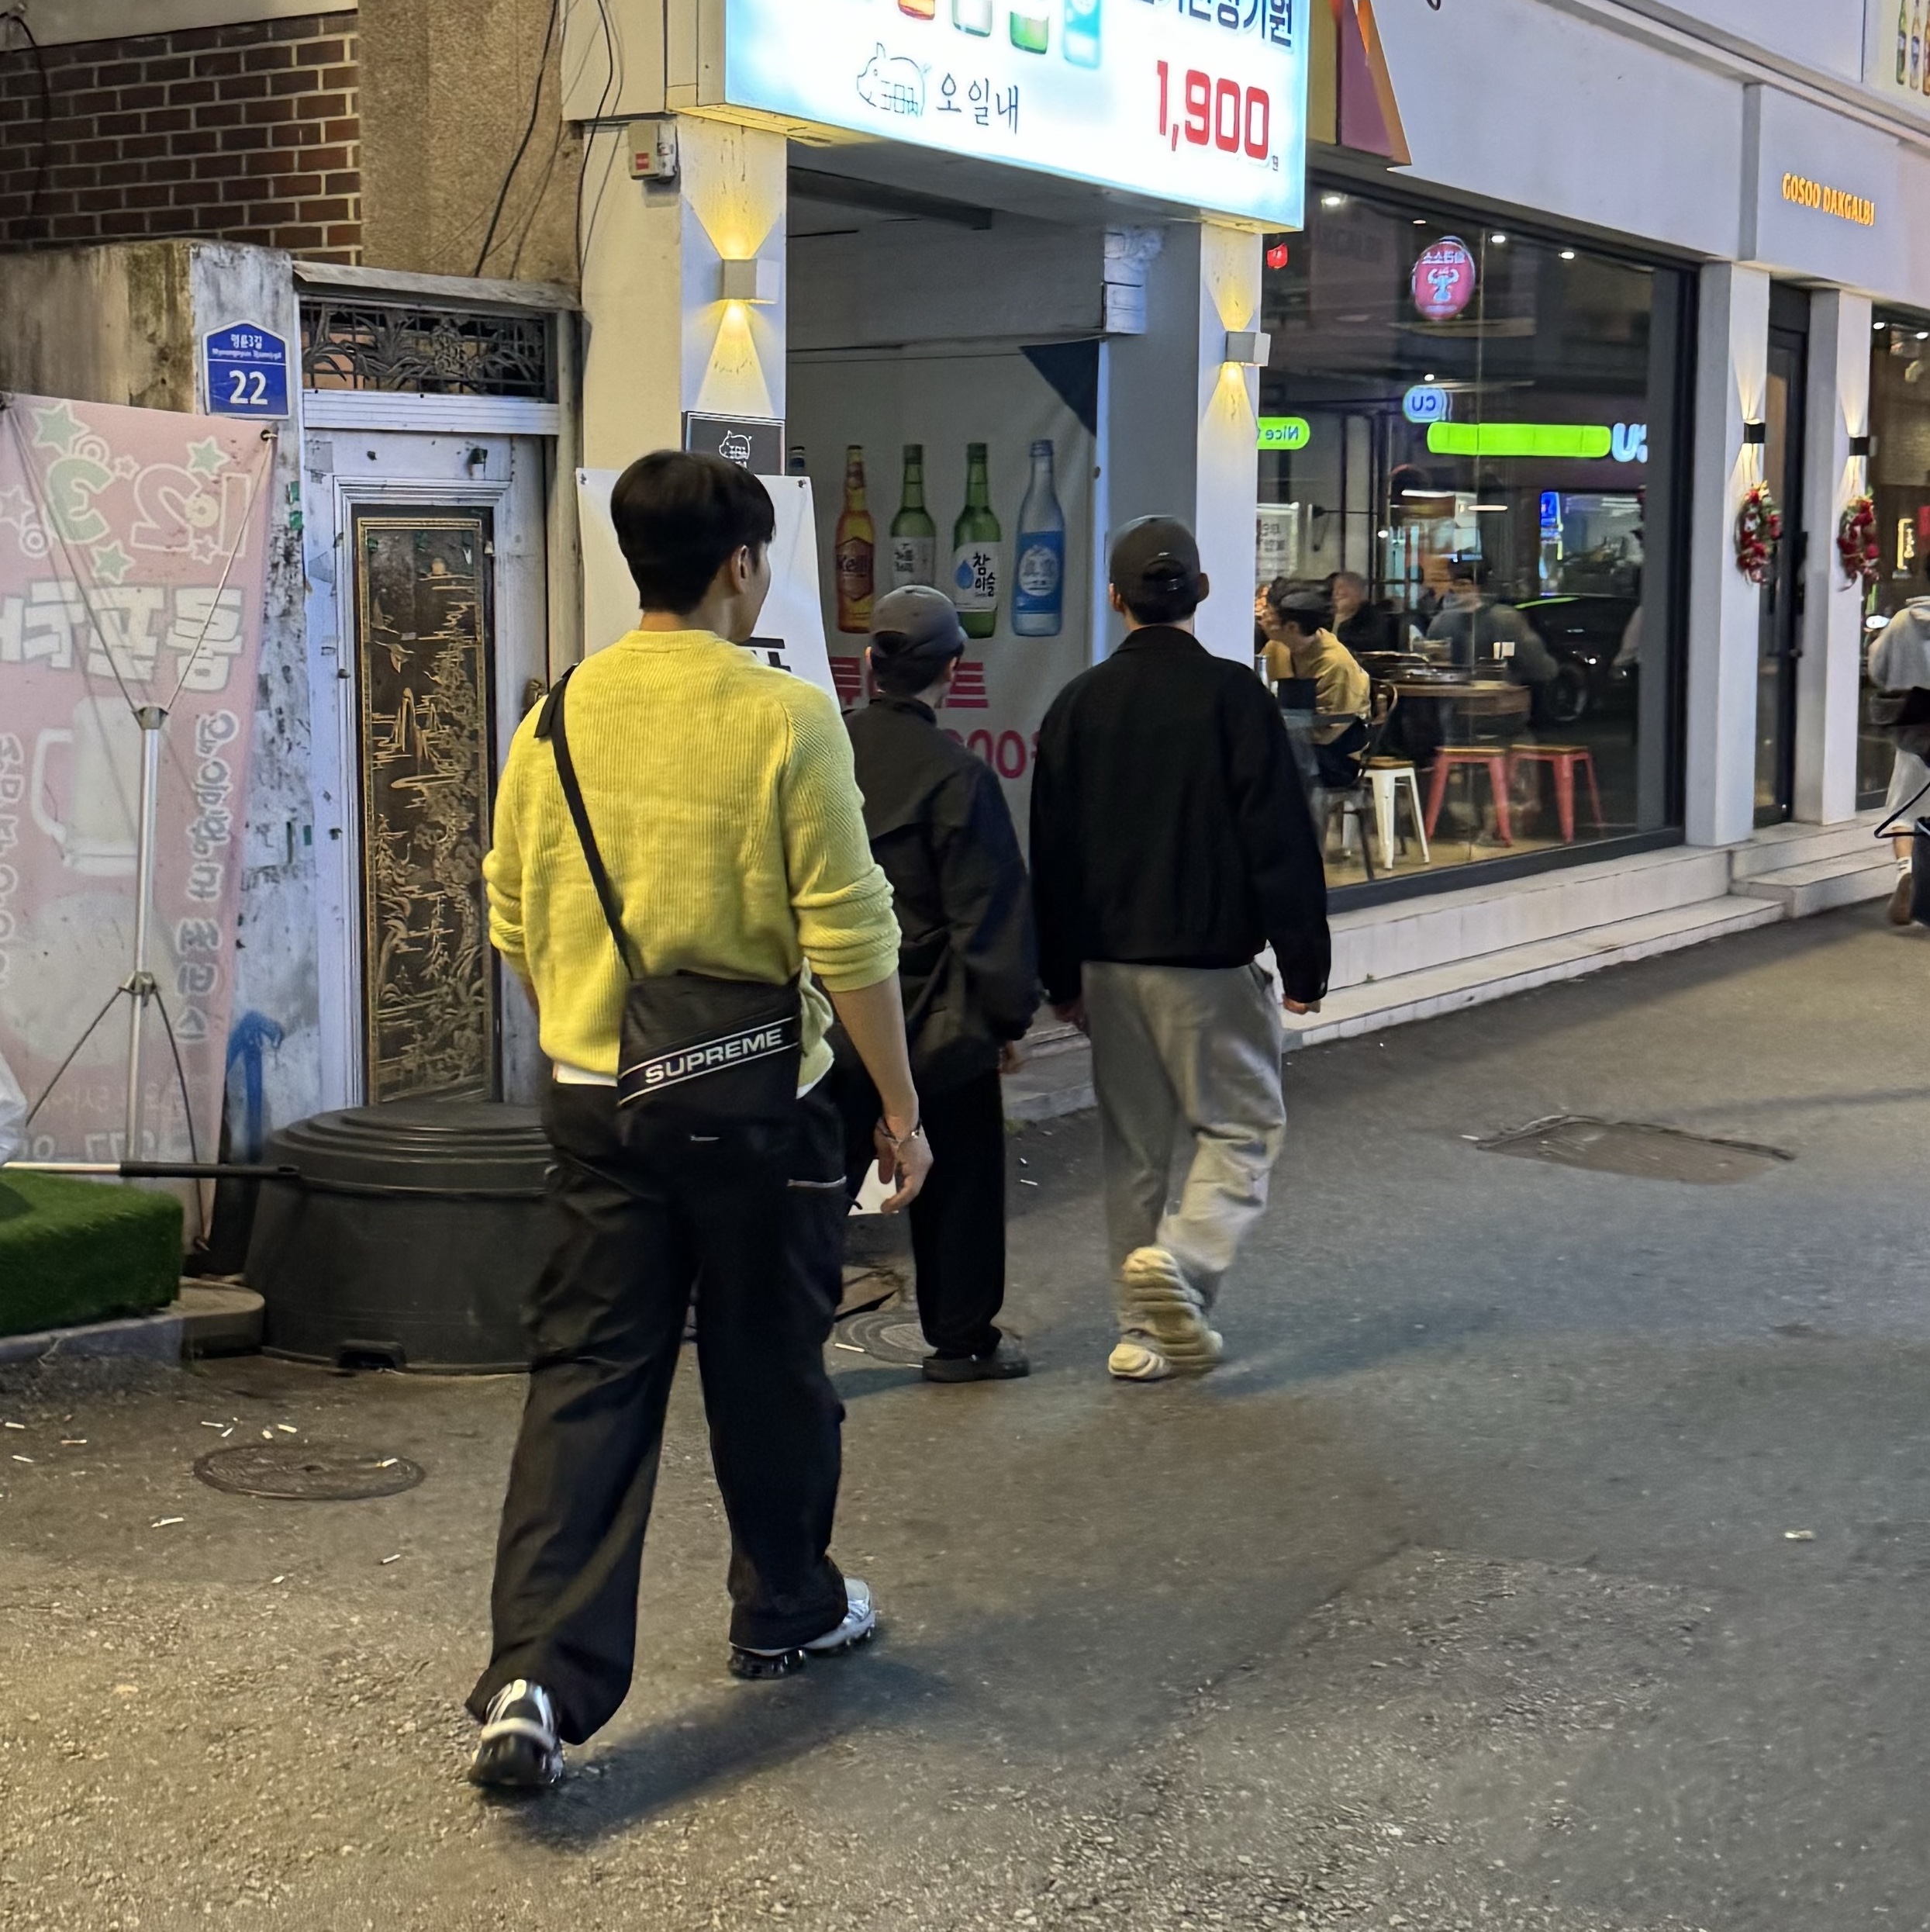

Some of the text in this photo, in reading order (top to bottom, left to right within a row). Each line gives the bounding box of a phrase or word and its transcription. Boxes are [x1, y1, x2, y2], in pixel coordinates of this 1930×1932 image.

[935, 73, 1019, 134] 오일내
[1157, 60, 1269, 161] 1,900
[1783, 172, 1875, 226] GOSOO DAKGALBI
[230, 371, 268, 405] 22
[644, 1028, 783, 1084] SUPREME
